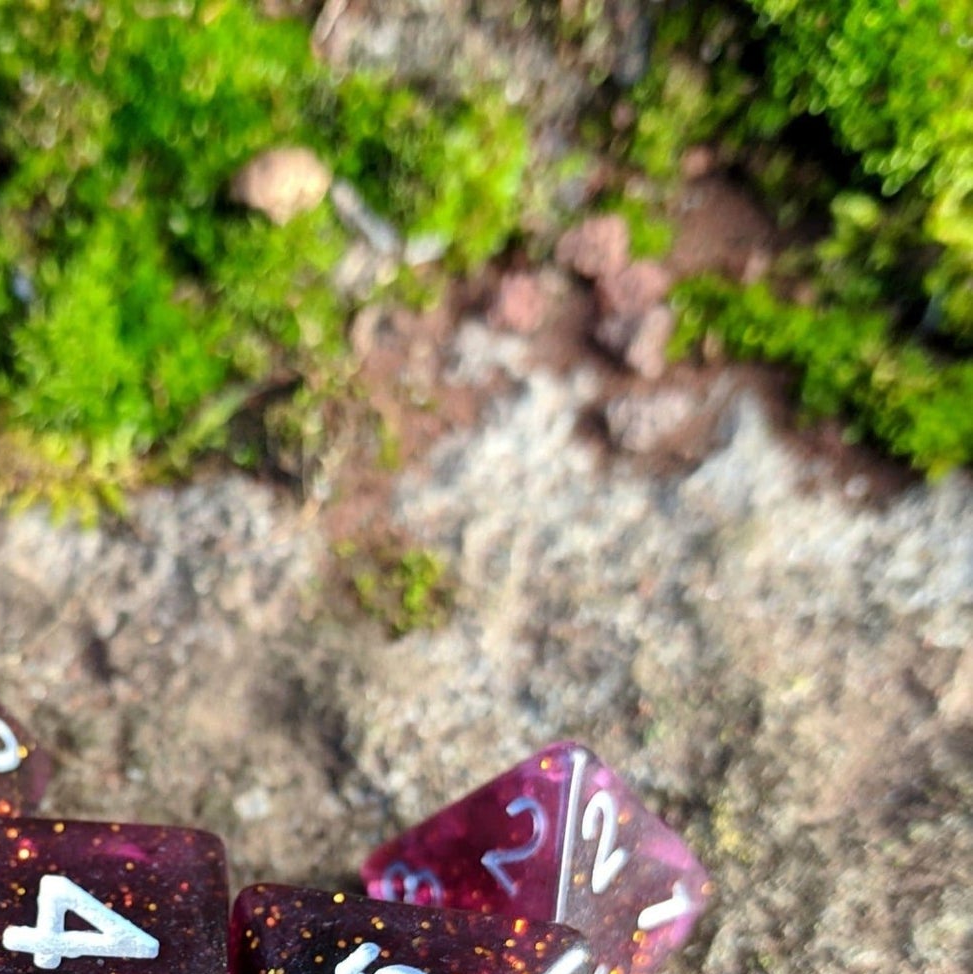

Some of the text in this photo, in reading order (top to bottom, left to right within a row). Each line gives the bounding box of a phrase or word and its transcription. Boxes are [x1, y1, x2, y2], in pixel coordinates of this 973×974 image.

[480, 796, 549, 897] 2
[582, 790, 627, 893] 2
[2, 874, 160, 970] 4
